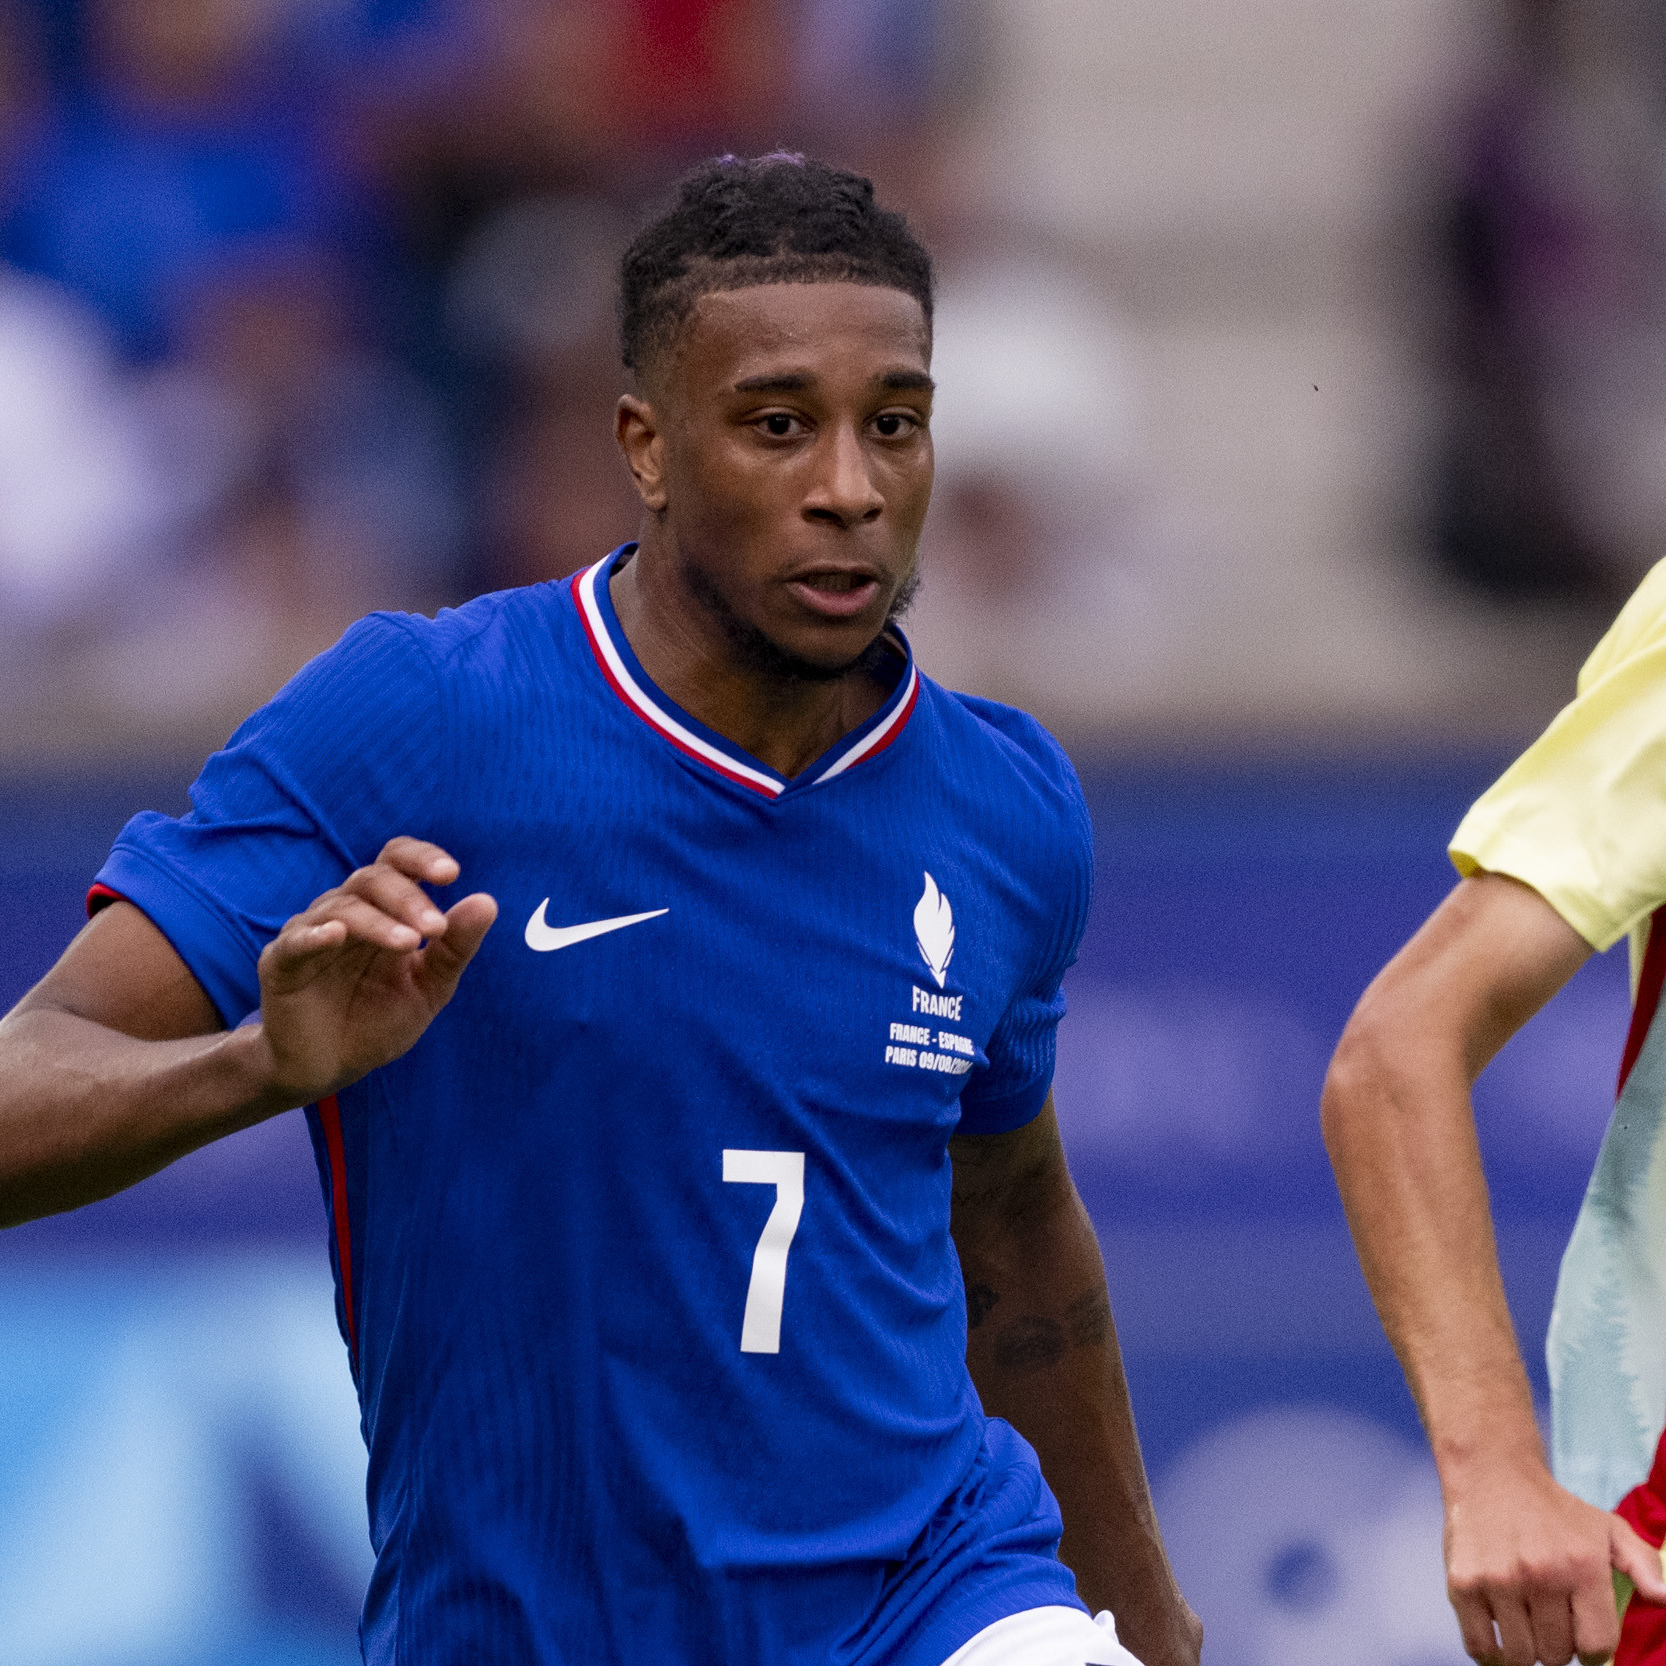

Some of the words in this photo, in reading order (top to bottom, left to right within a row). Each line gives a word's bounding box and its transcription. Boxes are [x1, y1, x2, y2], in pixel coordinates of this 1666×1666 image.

[912, 985, 963, 1021] FRANCE
[890, 1023, 930, 1046] FRANCE
[885, 1045, 917, 1067] PARIS
[722, 1148, 805, 1354] 7
